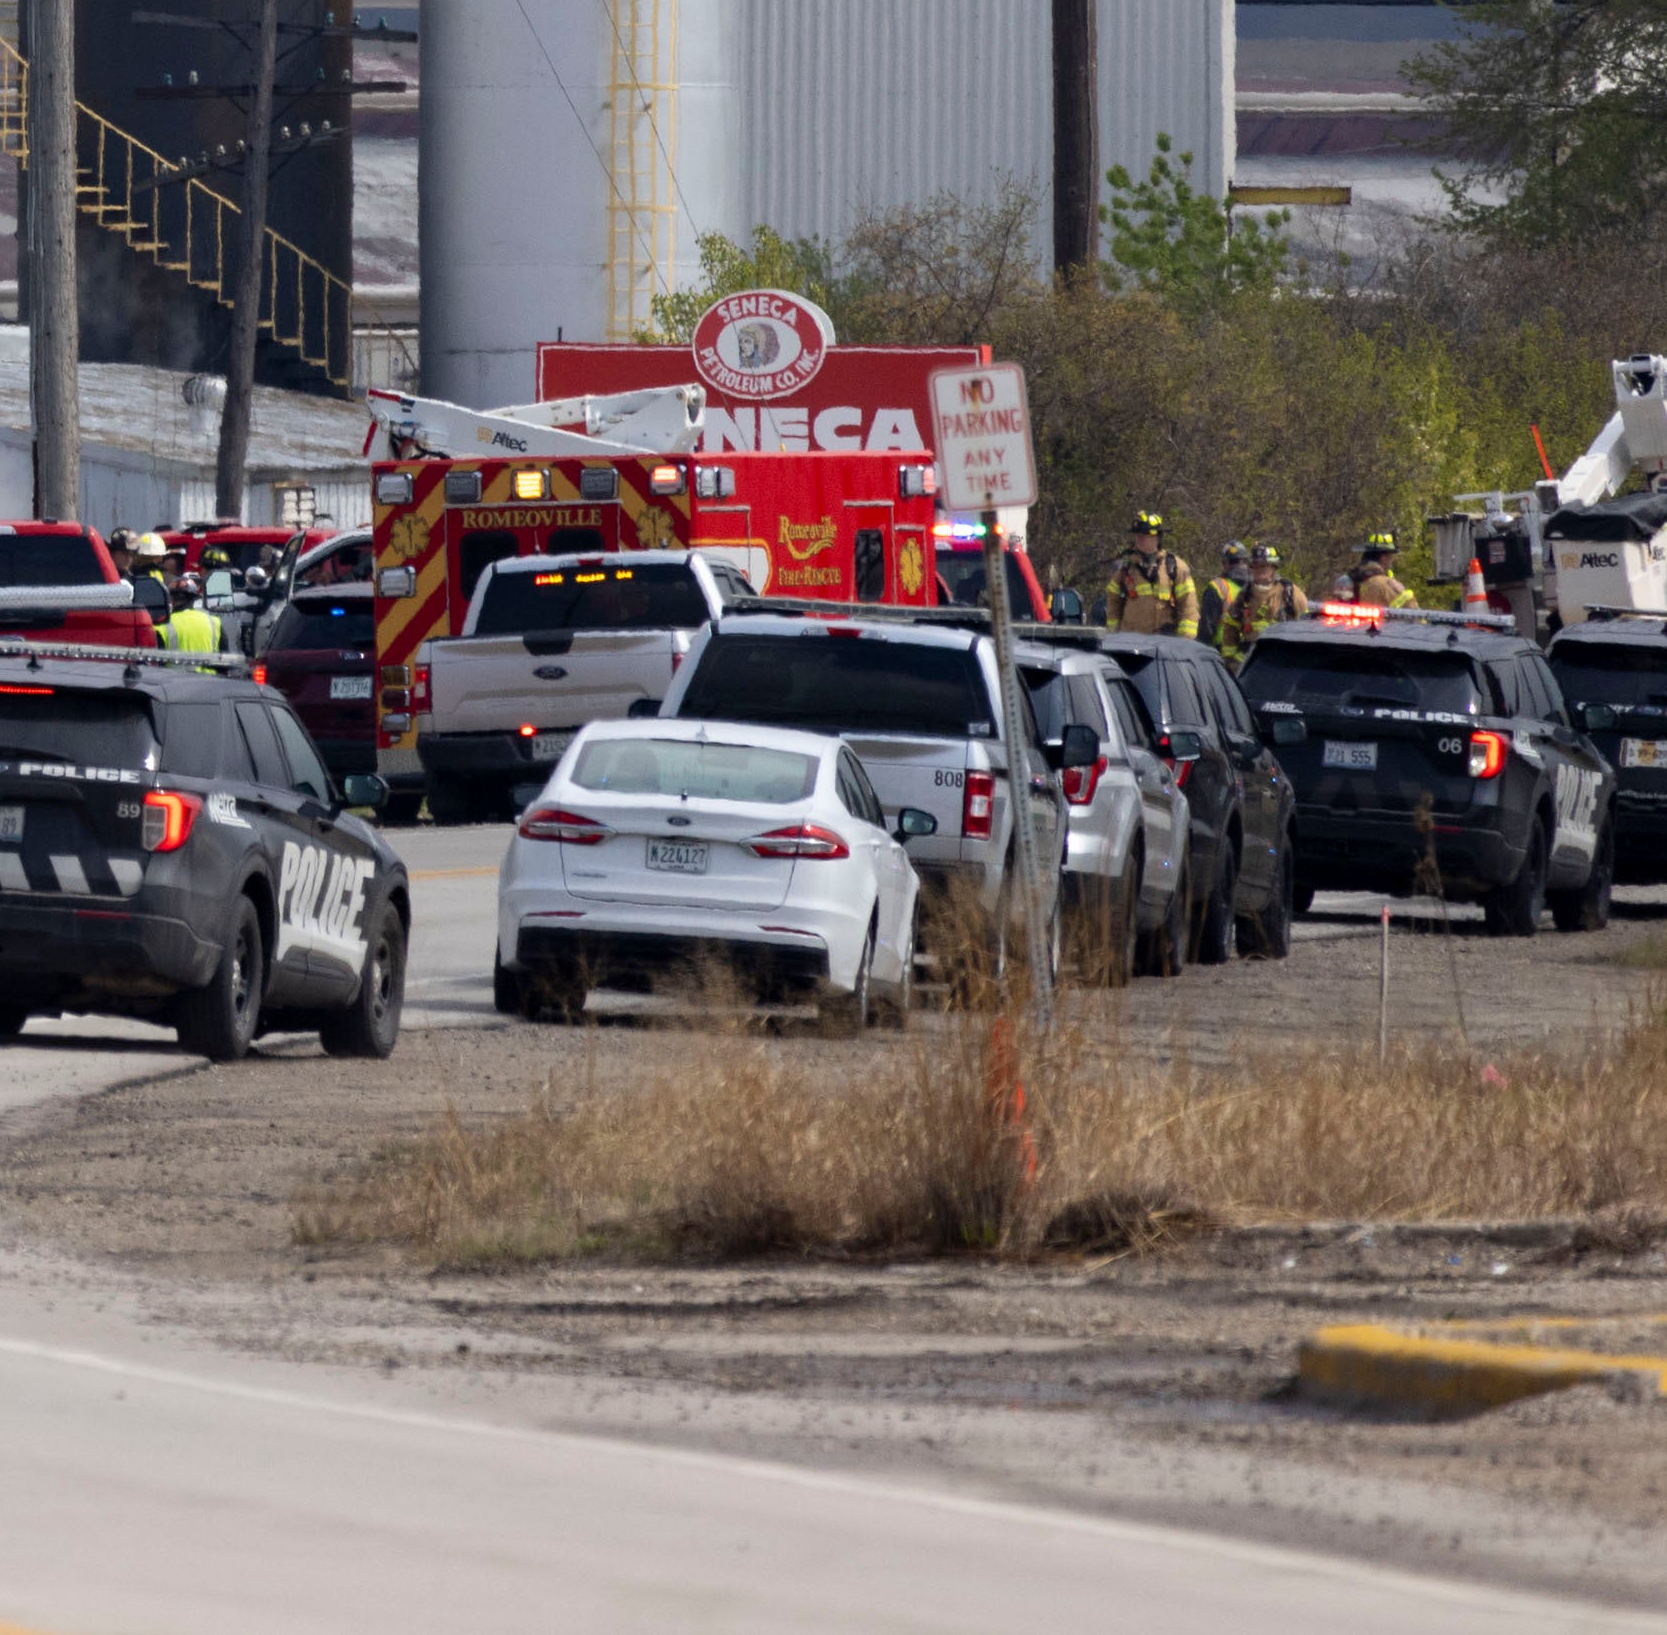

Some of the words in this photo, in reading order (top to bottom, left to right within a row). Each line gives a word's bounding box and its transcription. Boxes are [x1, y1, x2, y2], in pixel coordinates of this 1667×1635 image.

[717, 296, 798, 326] SENECA
[700, 346, 773, 394] PETROLEUM
[775, 371, 800, 388] CO.
[793, 348, 819, 376] INC.
[959, 376, 995, 405] NO
[941, 408, 1024, 441] PARKING
[491, 431, 528, 453] Altec
[963, 447, 1006, 468] ANY
[965, 472, 1012, 493] TIME
[461, 508, 603, 529] ROMEOVILLE
[778, 516, 837, 547] Romeoville
[1579, 552, 1618, 568] Altec
[1374, 708, 1468, 724] POLICE
[1437, 737, 1462, 754] 06
[19, 763, 141, 783] POLICE
[934, 770, 963, 788] 808
[117, 802, 141, 818] 89
[278, 840, 375, 940] POLICE
